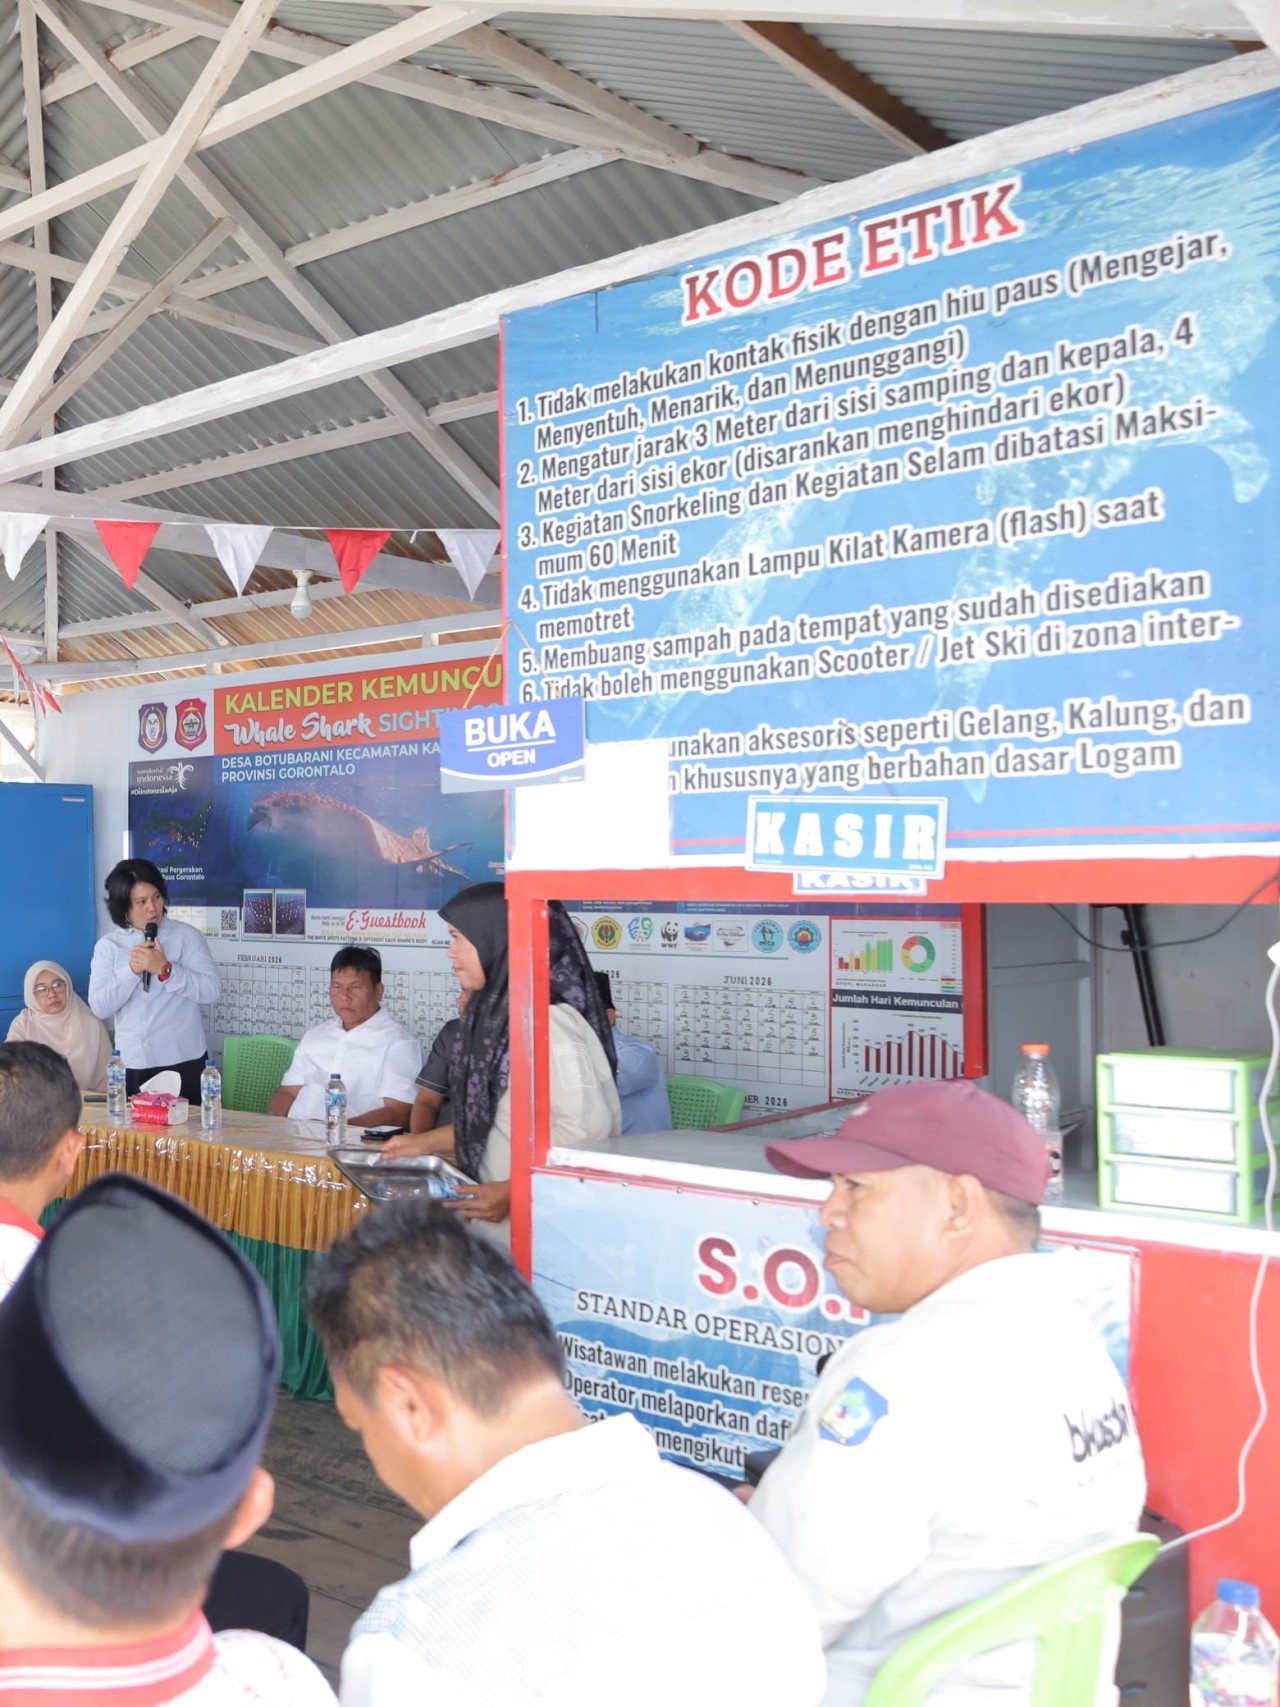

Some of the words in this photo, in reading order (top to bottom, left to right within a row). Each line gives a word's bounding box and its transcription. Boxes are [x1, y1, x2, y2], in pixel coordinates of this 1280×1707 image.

[685, 231, 846, 322] KODE
[863, 181, 1020, 272] ETIK
[517, 401, 532, 423] 1.
[538, 386, 587, 418] Tidak
[593, 361, 702, 405] melakukan
[709, 339, 785, 375] kontak
[791, 321, 842, 356] fisik
[849, 303, 937, 344] dengan
[946, 288, 985, 319] hiu
[997, 272, 1058, 312] paus
[1069, 234, 1227, 293] (Mengejar,
[520, 462, 536, 486] 2.
[542, 445, 632, 482] Mengatur
[636, 429, 688, 465] jarak
[695, 424, 708, 448] 3
[715, 410, 778, 444] Meter
[785, 397, 830, 429] dari
[837, 386, 876, 418] sisi
[884, 364, 992, 408] samping
[1001, 354, 1050, 383] dan
[1059, 328, 1165, 372] kepala,
[1174, 316, 1194, 346] 4
[536, 408, 645, 451] Menyentuh,
[651, 384, 740, 421] Menarik,
[748, 374, 787, 402] dan
[795, 329, 965, 391] Menunggangi)
[538, 485, 591, 514] Meter
[596, 477, 635, 508] dari
[640, 466, 674, 499] sisi
[680, 457, 729, 488] ekor
[735, 428, 869, 478] (disarankan
[878, 390, 1040, 447] menghindari
[1050, 373, 1126, 411] ekor)
[520, 524, 537, 547] 3.
[542, 511, 624, 545] Kegiatan
[630, 490, 742, 529] Snorkeling
[748, 477, 787, 506] dan
[795, 460, 899, 501] Kegiatan
[907, 444, 985, 478] Selam
[995, 418, 1104, 463] dibatasi
[1114, 399, 1218, 442] Maksi-
[520, 587, 538, 611] 4.
[543, 578, 593, 606] Tidak
[599, 557, 741, 599] menggunakan
[748, 546, 821, 577] Lampu
[828, 533, 885, 565] Kilat
[892, 521, 990, 555] Kamera
[999, 499, 1087, 544] (flash)
[1096, 490, 1160, 525] saat
[538, 553, 584, 577] mum
[589, 543, 615, 567] 60
[621, 534, 679, 562] Menit
[521, 651, 539, 674] 5.
[544, 640, 646, 672] Membuang
[652, 630, 733, 661] sampah
[739, 616, 791, 650] pada
[798, 609, 882, 640] tempat
[890, 603, 949, 635] yang
[958, 588, 1036, 622] sudah
[1045, 573, 1206, 612] disediakan
[538, 607, 632, 641] memotret
[522, 682, 540, 704] 6.
[542, 675, 594, 700] Tidak
[600, 671, 653, 698] boleh
[660, 655, 811, 692] menggunakan
[818, 643, 910, 676] Scooter
[919, 638, 932, 665] /
[938, 635, 976, 664] Jet
[985, 628, 1027, 658] Ski
[1037, 625, 1062, 653] di
[1071, 619, 1138, 650] zona
[1147, 613, 1237, 643] inter-
[224, 681, 355, 716] KALENDER
[223, 717, 297, 748] Whale
[300, 711, 378, 743] Shark
[464, 709, 557, 747] BUKA
[748, 723, 857, 751] aksesoris
[864, 715, 950, 752] seperti
[958, 708, 1060, 740] Gelang,
[1069, 700, 1178, 735] Kalung,
[1189, 694, 1246, 724] dan
[221, 755, 252, 770] DESA
[254, 748, 334, 767] BOTUBARANI
[336, 743, 419, 763] KECAMATAN
[221, 768, 276, 784] PROVINSI
[278, 763, 356, 780] GORONTALO
[486, 748, 536, 768] OPEN
[684, 765, 798, 793] khususnya
[805, 760, 861, 788] yang
[868, 755, 986, 783] berbahan
[995, 749, 1070, 775] dasar
[1079, 742, 1177, 776] Logam
[755, 812, 937, 861] KASIR
[345, 910, 426, 932] E-Guestbook
[237, 954, 267, 963] FEBRUARI
[723, 975, 748, 985] JUNI
[749, 976, 772, 986] 2026
[833, 993, 868, 1004] Jumlah
[871, 995, 892, 1005] Hari
[893, 997, 959, 1009] Kemunculan
[765, 1096, 788, 1107] 2026
[697, 1236, 868, 1320] S.O.
[576, 1290, 688, 1331] STANDAR
[560, 1335, 648, 1375] Wisatawan
[653, 1358, 756, 1398] melakukan
[564, 1369, 637, 1406] Operator
[641, 1390, 750, 1432] melaporkan
[656, 1428, 747, 1468] mengikuti
